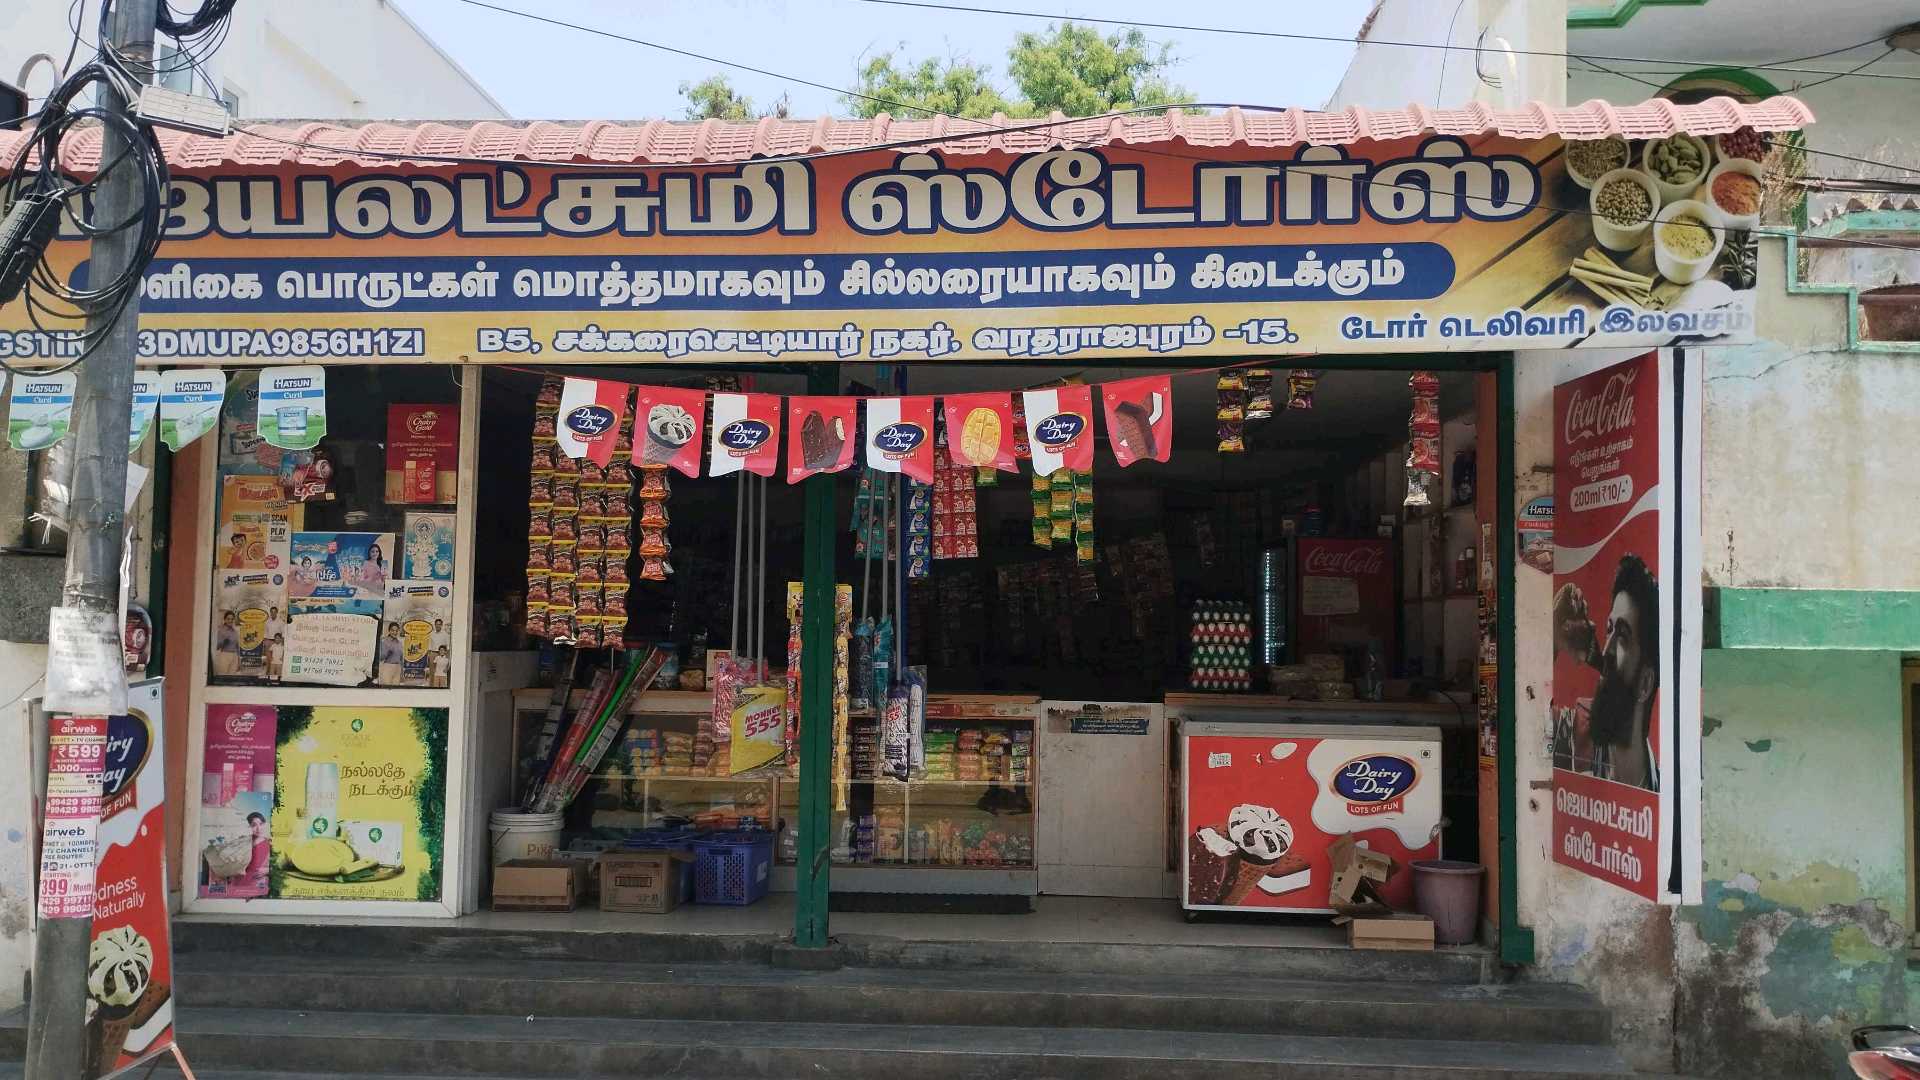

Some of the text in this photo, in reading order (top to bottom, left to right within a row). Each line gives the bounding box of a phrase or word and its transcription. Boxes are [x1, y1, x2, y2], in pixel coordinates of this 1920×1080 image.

[843, 136, 1541, 234] ஸ்டோர்ஸ்
[139, 247, 1405, 308] ளிகை பொருட்கள் மொத்தமாகவும் சில்லரையாகவும் கிடைக்கும்
[1341, 304, 1753, 343] டோர் டெலிவரி இலவசம்
[138, 328, 425, 357] 3DMUPA9856H1ZI
[478, 327, 542, 355] B5,
[871, 321, 962, 358] நகர்,
[972, 315, 1215, 358] வரதராஜபுரம்
[26, 384, 62, 393] HATSUN
[176, 382, 211, 392] HATSUN
[274, 378, 311, 389] HATSUN
[575, 408, 607, 424] Dairy
[578, 419, 602, 433] Day
[729, 424, 762, 437] Dairy
[883, 426, 917, 442] Dairy
[1043, 419, 1076, 432] Dairy
[733, 432, 759, 449] Day
[887, 437, 912, 451] Day
[1047, 429, 1073, 443] Day
[1528, 505, 1554, 515] HATS
[61, 724, 97, 733] airweb
[745, 713, 781, 737] 555
[107, 735, 134, 762] iry
[57, 763, 80, 772] 1000
[341, 760, 405, 781] நல்லதே
[1346, 760, 1402, 785] Dairy
[104, 768, 126, 793] ay
[349, 779, 417, 799] நடக்கும்
[1352, 777, 1394, 800] Day
[114, 793, 132, 811] FUN
[1350, 805, 1369, 814] LOTS
[1383, 802, 1399, 810] FUN
[1556, 787, 1653, 840] ஜெயலட்சுமி
[1564, 826, 1641, 883] ஸ்டோர்ஸ்
[42, 879, 68, 896] 399
[93, 891, 146, 921] Naturally
